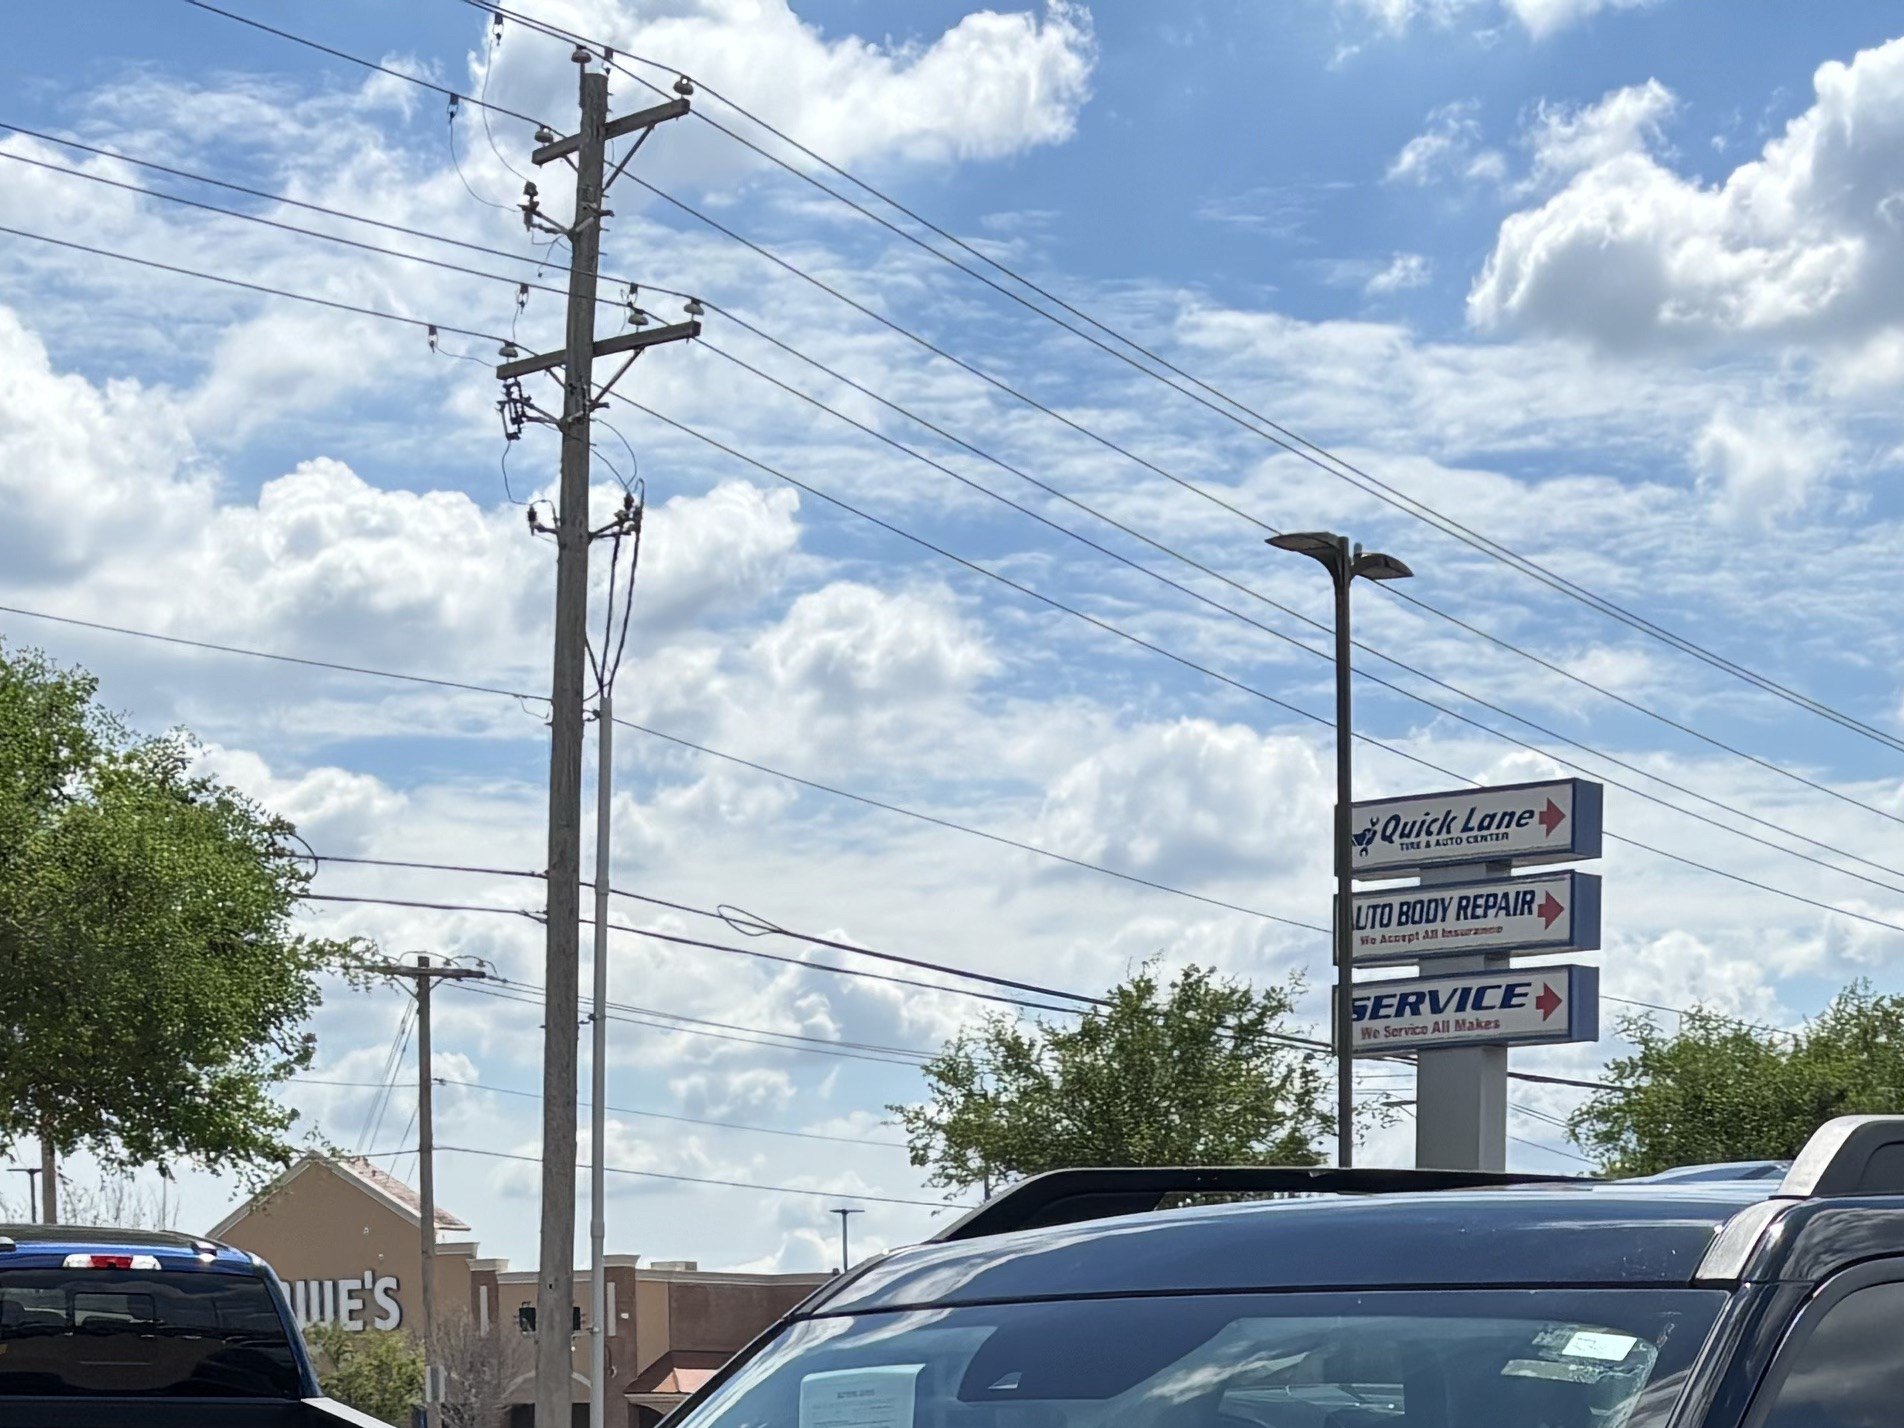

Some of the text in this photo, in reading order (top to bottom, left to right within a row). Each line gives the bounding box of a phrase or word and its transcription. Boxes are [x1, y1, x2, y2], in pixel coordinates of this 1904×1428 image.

[1380, 806, 1536, 845] Quick Lane
[1399, 832, 1510, 852] TIRE & AUTO CENTER
[1352, 889, 1536, 931] UTO BODY REPAIR
[1359, 935, 1377, 946] We
[1379, 931, 1420, 945] Accept
[1422, 928, 1440, 941] All
[1352, 982, 1533, 1022] SERVICE
[1360, 1018, 1501, 1040] We Service All Makes
[280, 1270, 401, 1332] WE'S
